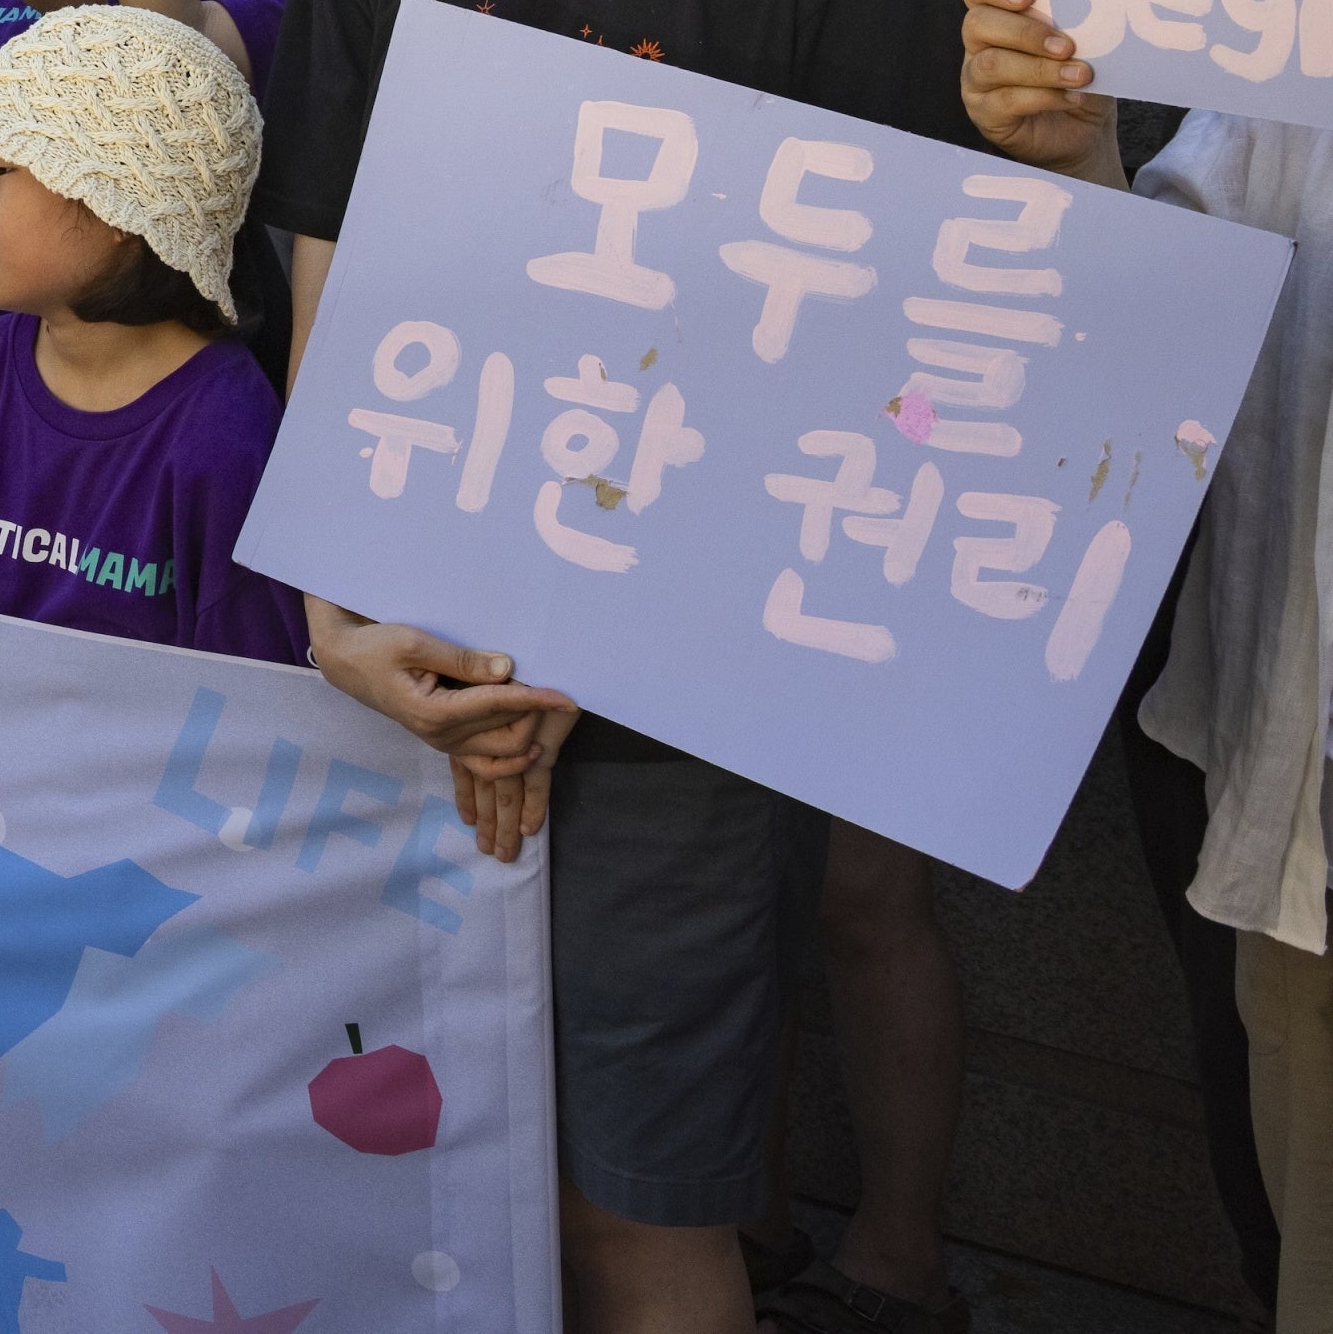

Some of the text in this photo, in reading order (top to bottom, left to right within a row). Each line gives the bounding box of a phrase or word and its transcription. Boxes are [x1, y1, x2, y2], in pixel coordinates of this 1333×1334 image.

[527, 98, 1073, 457] 모두를
[348, 319, 1131, 681] 위한 권리
[152, 684, 478, 934] LIFE
